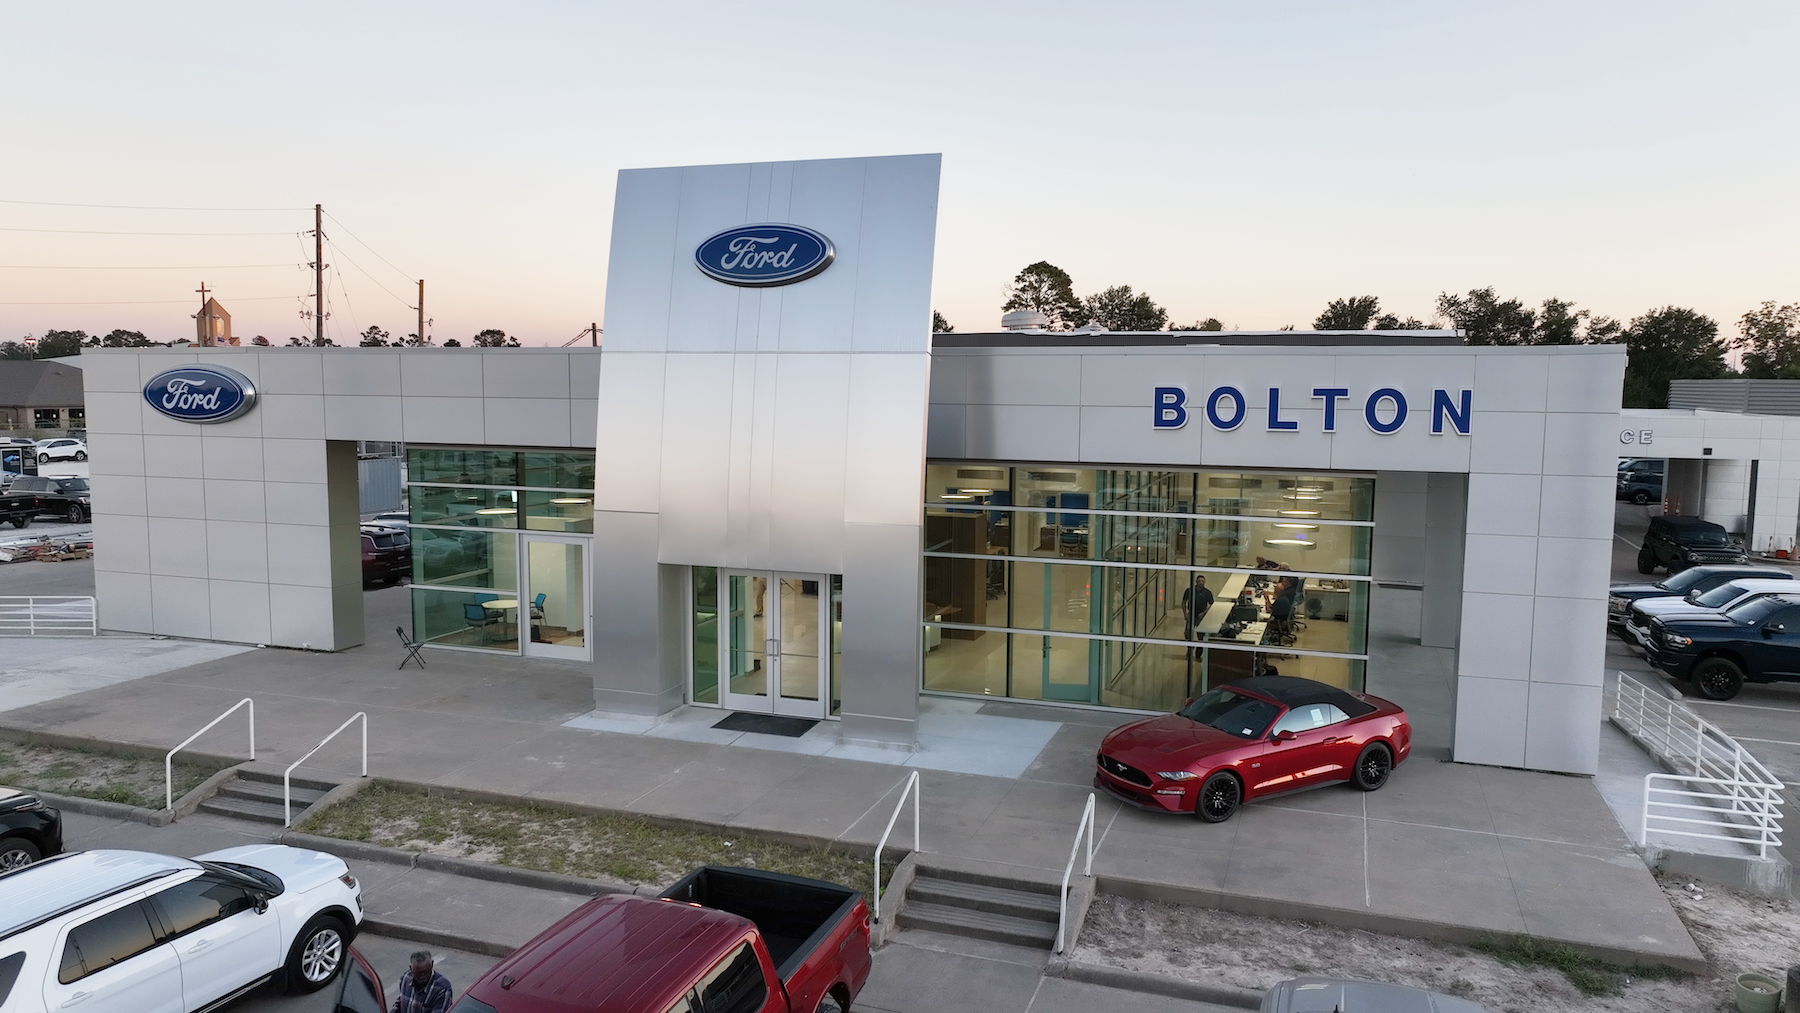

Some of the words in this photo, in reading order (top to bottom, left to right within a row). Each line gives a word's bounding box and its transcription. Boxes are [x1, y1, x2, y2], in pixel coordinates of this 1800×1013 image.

[720, 236, 798, 269] Ford
[162, 378, 221, 410] Ford
[1153, 385, 1473, 435] BOLTON
